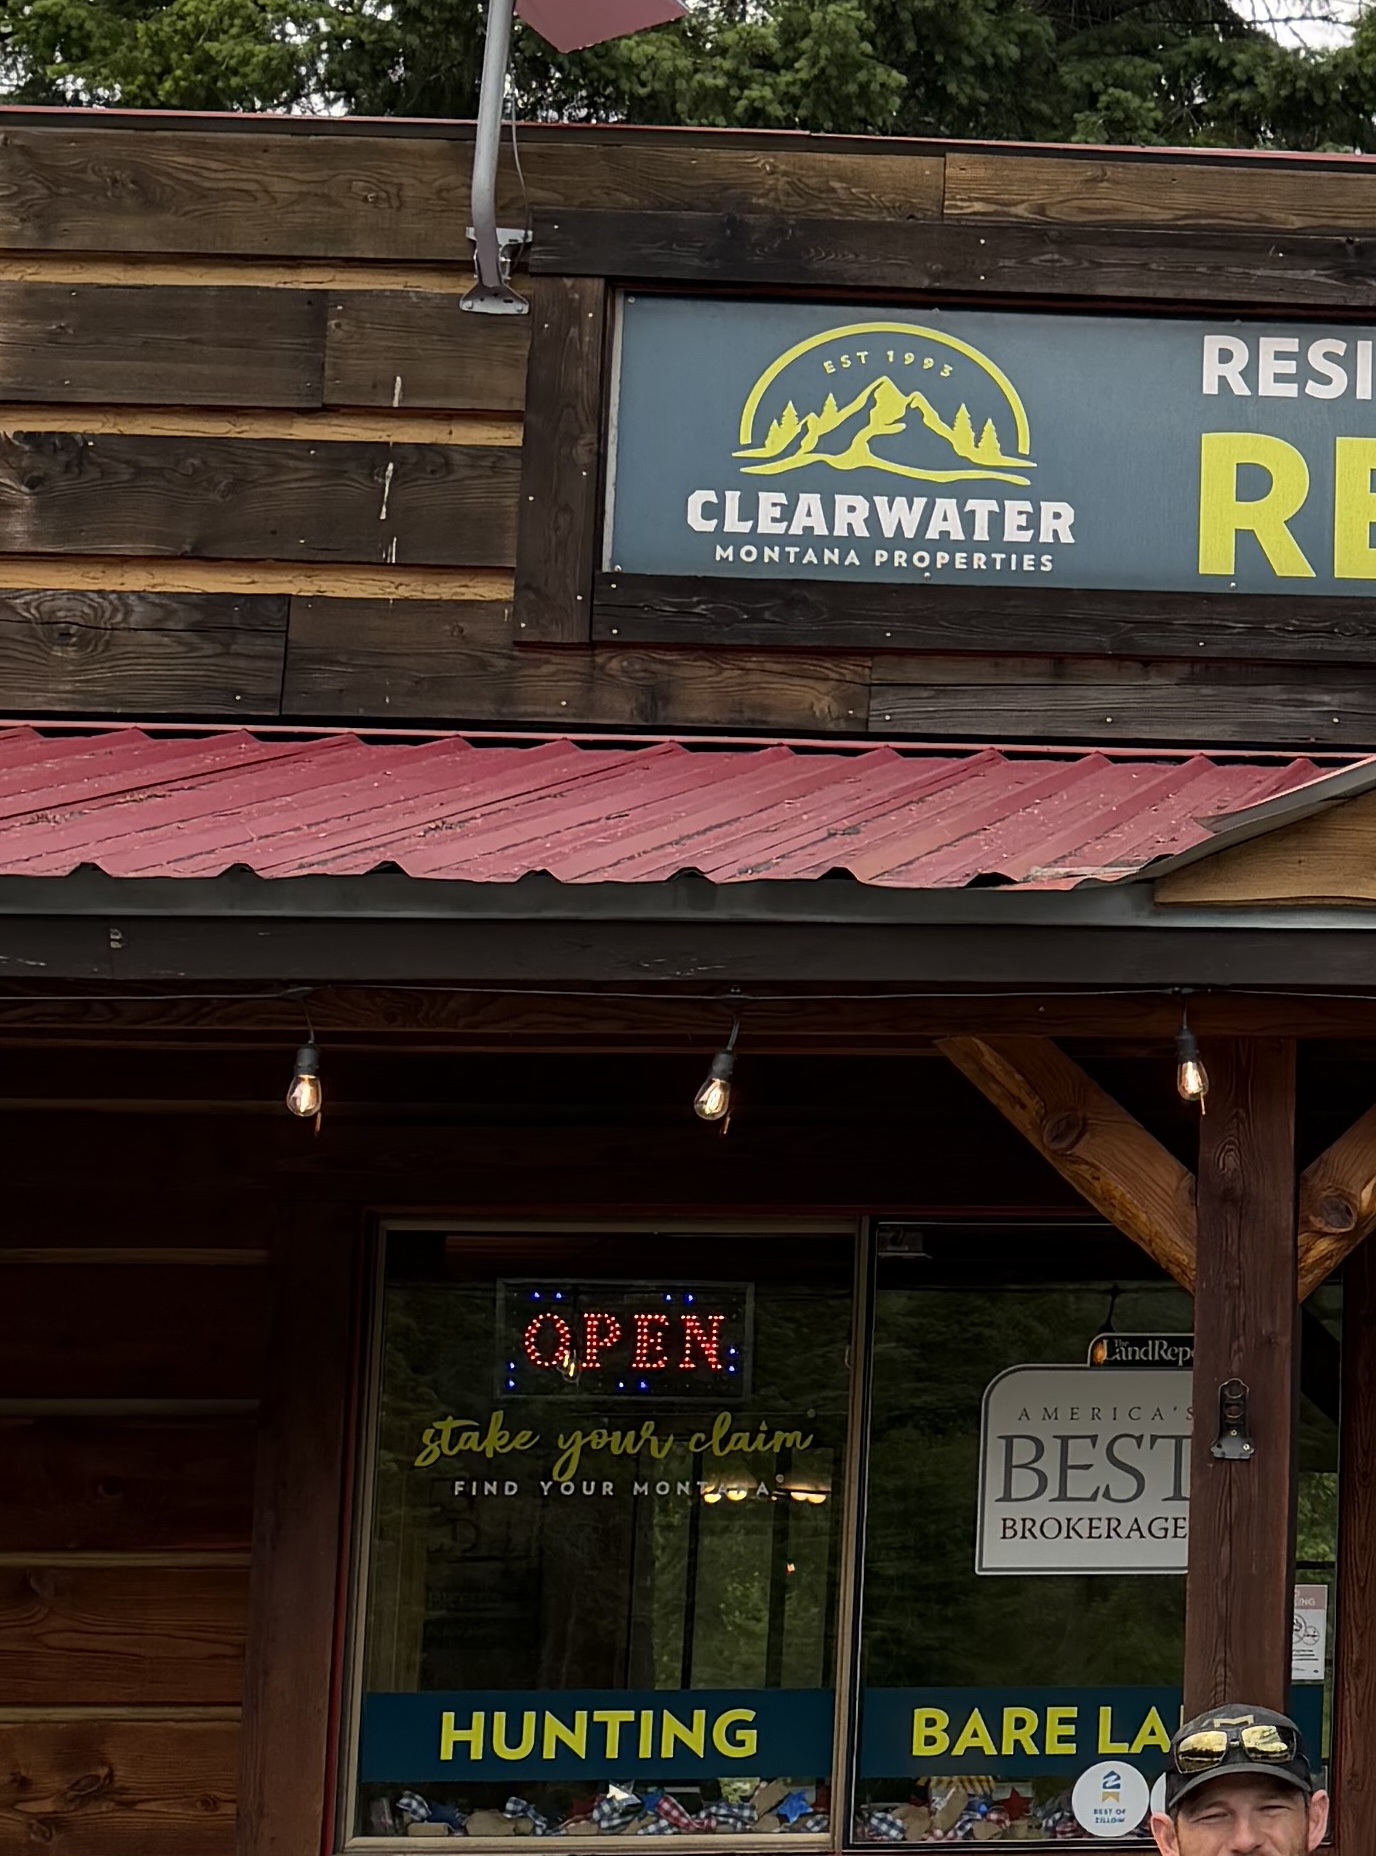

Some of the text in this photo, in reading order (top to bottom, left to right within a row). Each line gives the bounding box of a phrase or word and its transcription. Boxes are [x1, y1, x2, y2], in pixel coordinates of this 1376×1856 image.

[822, 350, 954, 379] EST 1993
[686, 488, 1076, 545] CLEARWATER
[714, 544, 1055, 573] MONTANA PROPERTIES
[522, 1311, 727, 1370] OPEN
[1103, 1339, 1194, 1367] LandRep
[1018, 1405, 1193, 1422] AMERICA'S
[414, 1409, 814, 1482] stake your claim
[453, 1480, 519, 1496] FIND
[540, 1480, 615, 1496] YOUR
[993, 1432, 1192, 1505] BEST
[1000, 1515, 1188, 1541] BROKERAGE
[439, 1708, 759, 1762] HUNTING
[911, 1705, 1184, 1758] BARE LA
